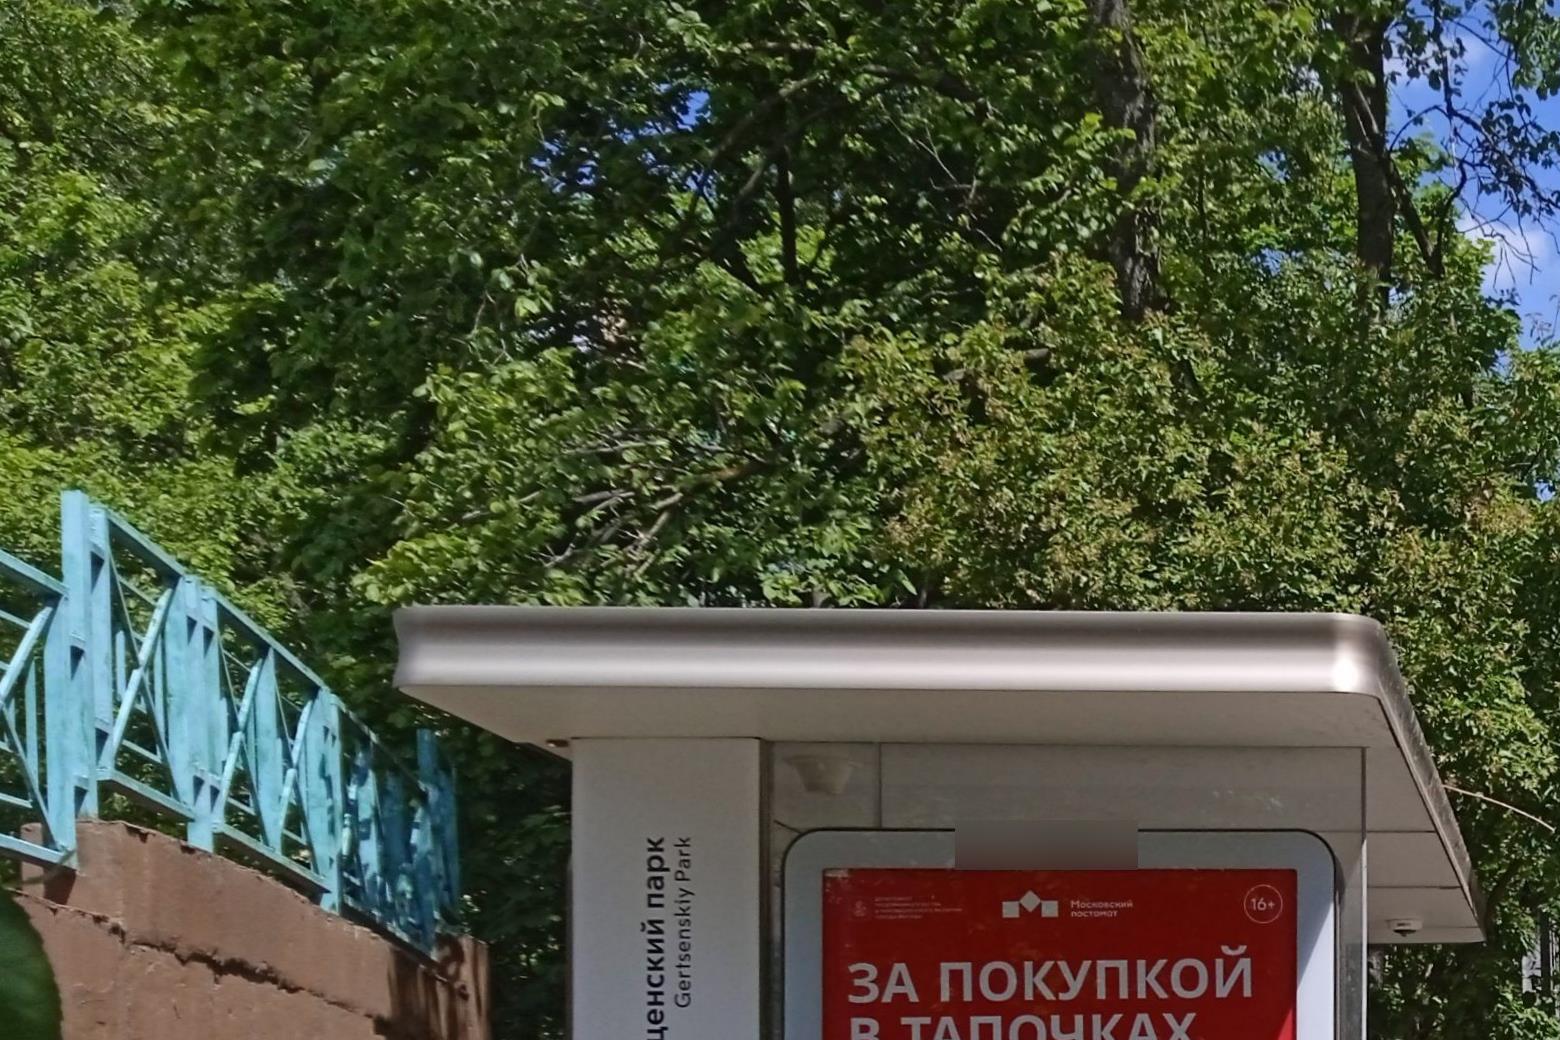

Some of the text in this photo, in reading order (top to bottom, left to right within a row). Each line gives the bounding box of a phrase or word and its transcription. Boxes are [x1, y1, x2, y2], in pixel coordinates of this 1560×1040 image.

[646, 837, 671, 909] парк
[1250, 897, 1275, 912] 16+
[674, 837, 695, 1008] Gertsenskiy Park
[847, 944, 1253, 1004] ЗА ПОКУПКОЙ
